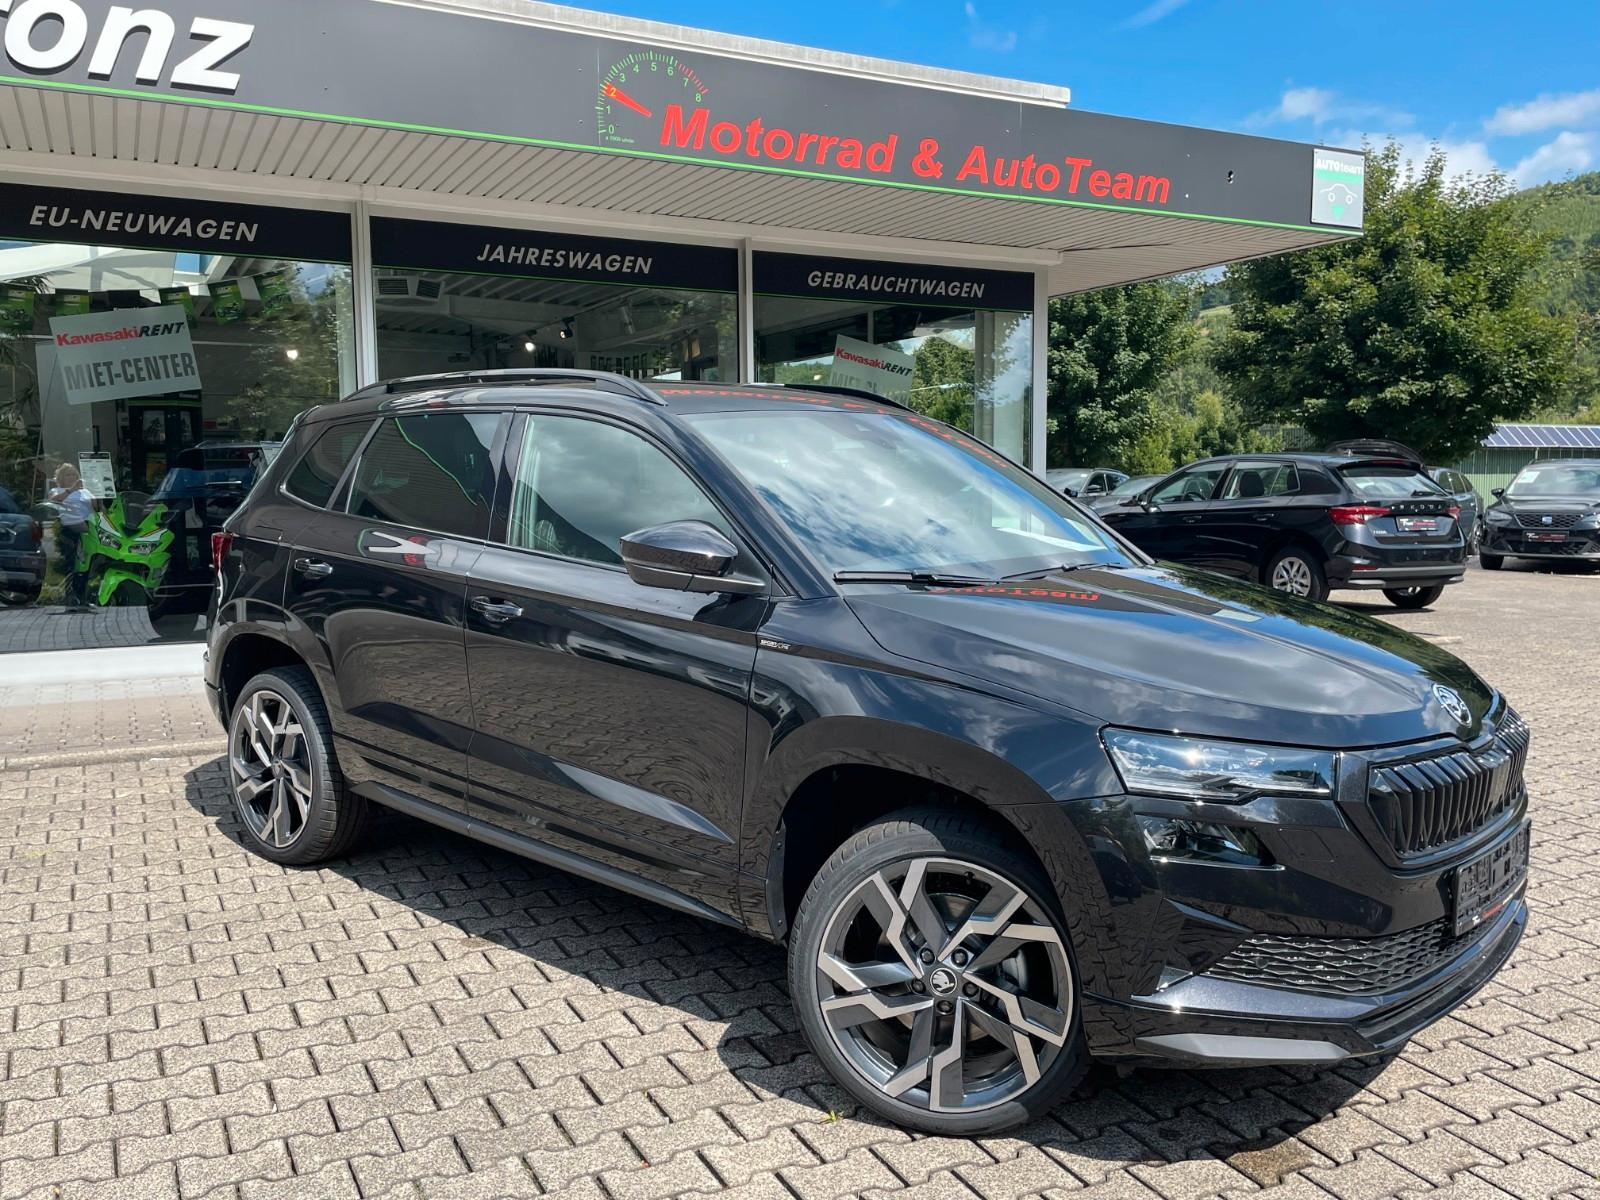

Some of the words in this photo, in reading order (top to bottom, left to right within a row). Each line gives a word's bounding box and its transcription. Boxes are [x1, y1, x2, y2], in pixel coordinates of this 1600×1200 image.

[0, 0, 255, 95] onz
[633, 64, 639, 73] 4
[650, 62, 657, 71] 5
[667, 66, 674, 76] 6
[619, 73, 626, 83] 3
[682, 77, 689, 87] 7
[610, 87, 617, 97] 2
[695, 93, 702, 102] 8
[606, 105, 612, 114] 1
[608, 124, 615, 134] 0
[660, 103, 898, 173] Motorrad
[911, 137, 943, 179] &
[956, 145, 1170, 204] AutoTeam
[29, 205, 258, 242] EU-NEUWAGEN
[477, 244, 652, 274] JAHRESWAGEN
[807, 271, 985, 298] GEBRAUCHTWAGEN
[56, 322, 185, 346] KawasakiRENT
[64, 352, 196, 390] MIET-CENTER
